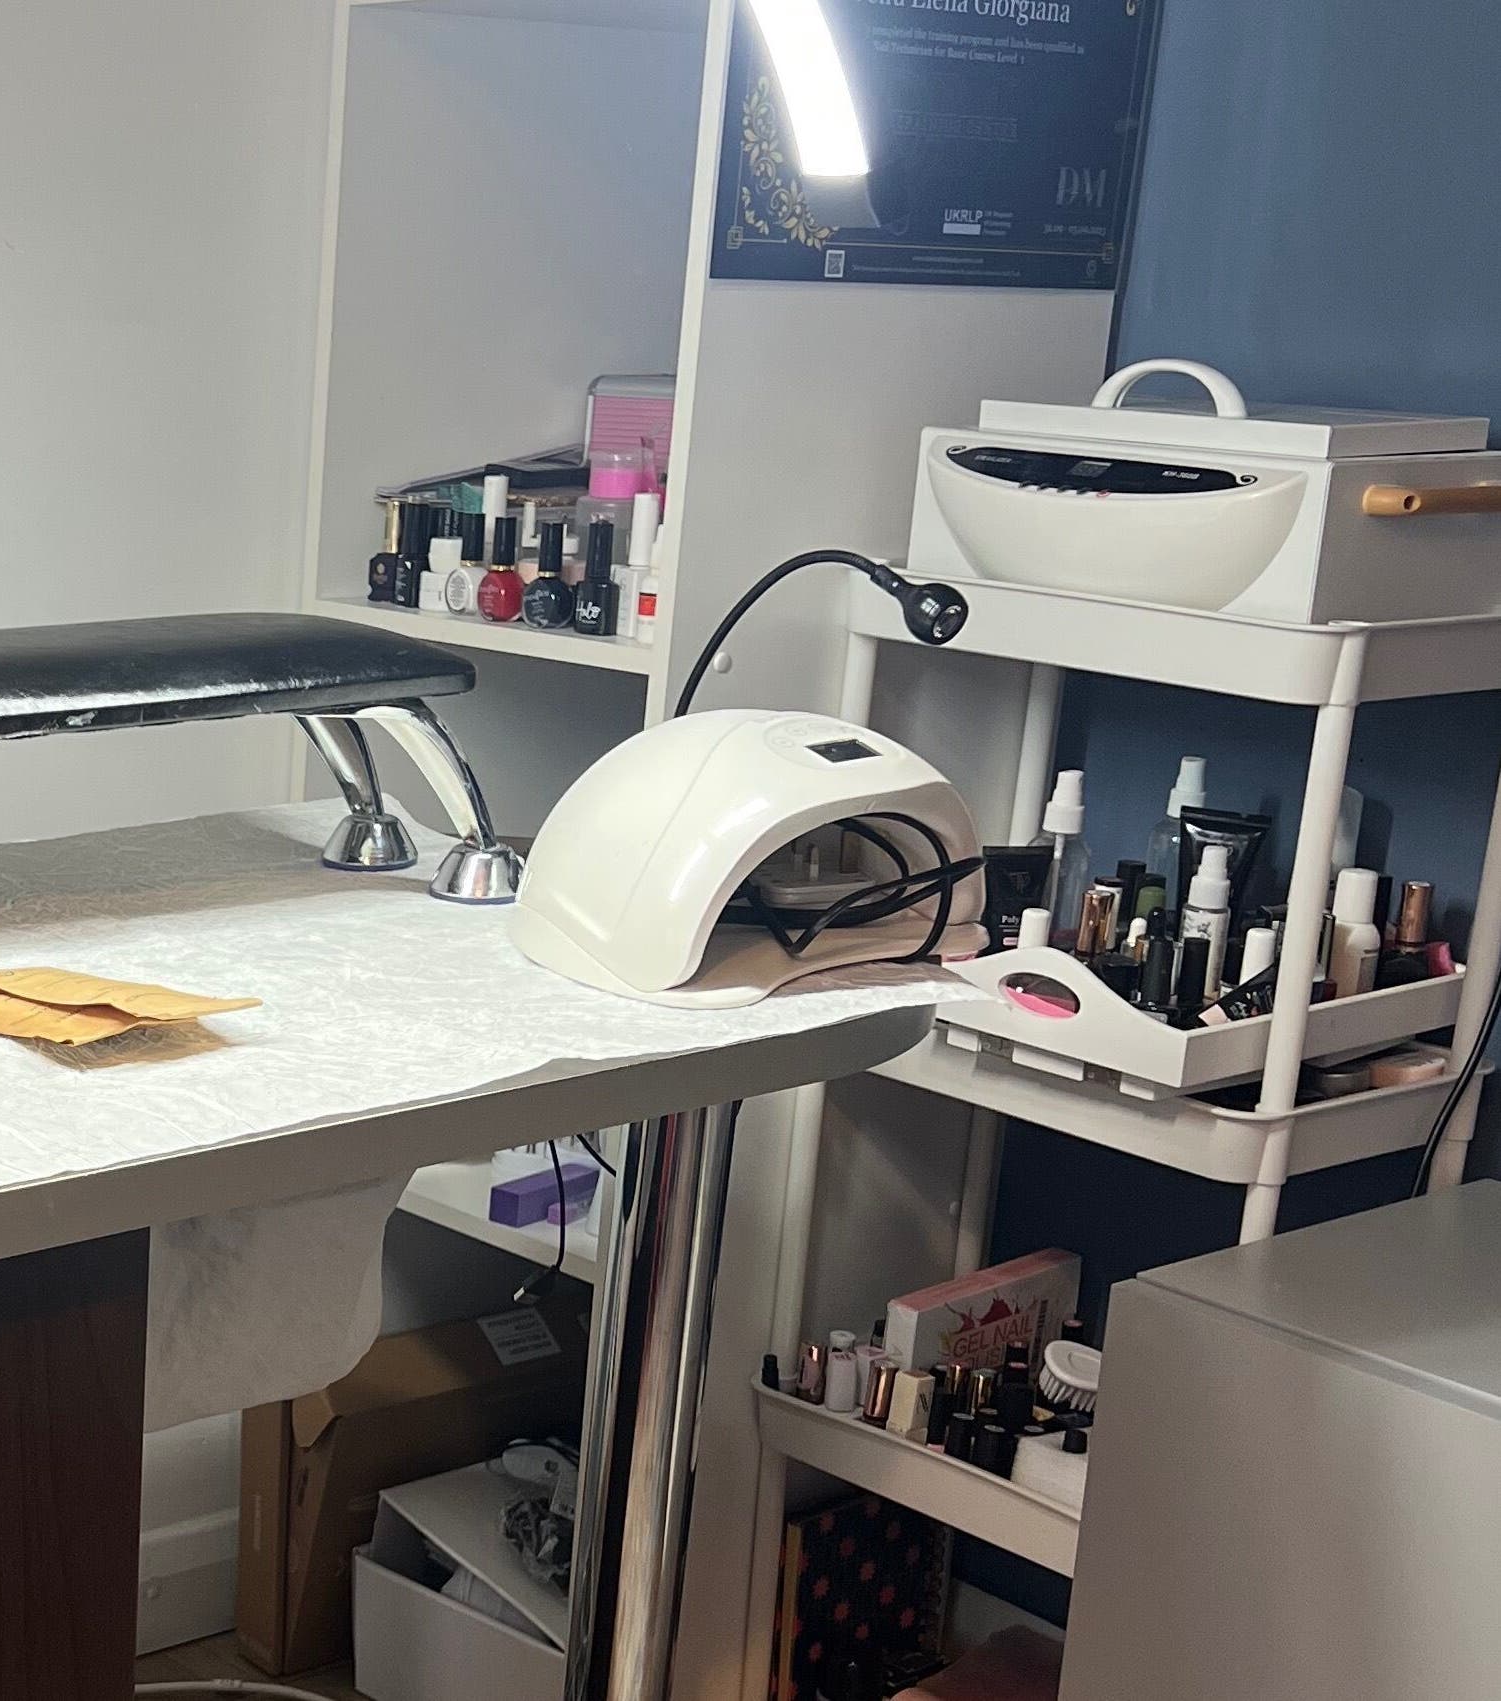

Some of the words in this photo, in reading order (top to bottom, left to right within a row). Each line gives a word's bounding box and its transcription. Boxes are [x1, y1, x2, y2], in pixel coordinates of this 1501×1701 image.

[974, 0, 1070, 25] Giorgiana
[944, 208, 983, 222] UKRLP
[953, 1330, 990, 1358] GEL
[992, 1314, 1034, 1346] NAIL
